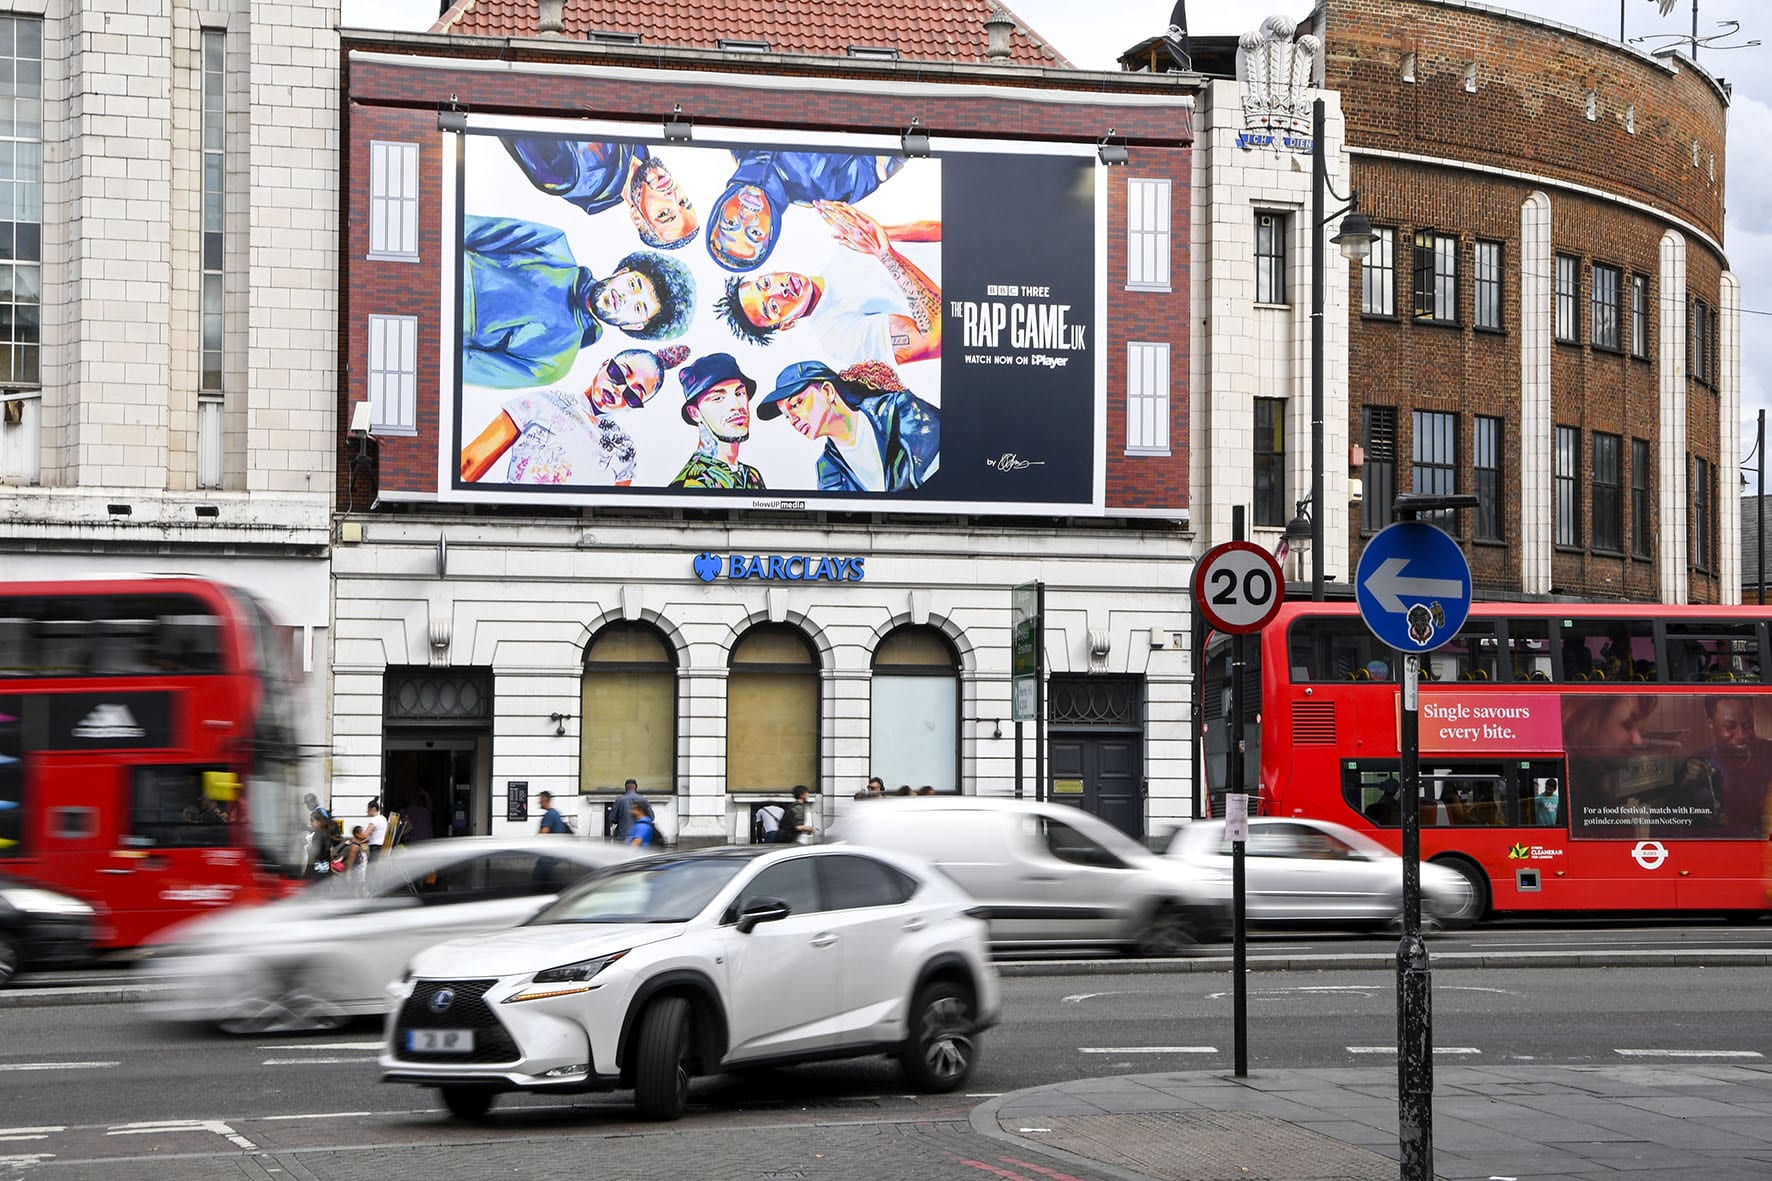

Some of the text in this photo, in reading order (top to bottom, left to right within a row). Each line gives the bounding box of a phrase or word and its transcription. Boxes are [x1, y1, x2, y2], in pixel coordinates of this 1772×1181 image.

[1247, 134, 1312, 148] ICH DIEN
[987, 285, 1050, 298] BBC THREE
[950, 301, 1086, 350] THE RAP GAME UK
[964, 354, 991, 364] WATCH
[994, 355, 1013, 365] NOW
[1015, 356, 1028, 365] ON
[986, 458, 996, 467] by
[780, 501, 805, 510] media
[728, 555, 865, 581] BARCLAYS
[1211, 568, 1272, 605] 20
[1424, 703, 1530, 721] Single savours
[1439, 724, 1516, 742] every bite.
[1583, 806, 1596, 814] For
[1602, 806, 1619, 814] food
[1620, 806, 1648, 815] festival,
[1649, 806, 1675, 814] match
[1675, 806, 1689, 814] with
[1689, 806, 1713, 814] Eman.
